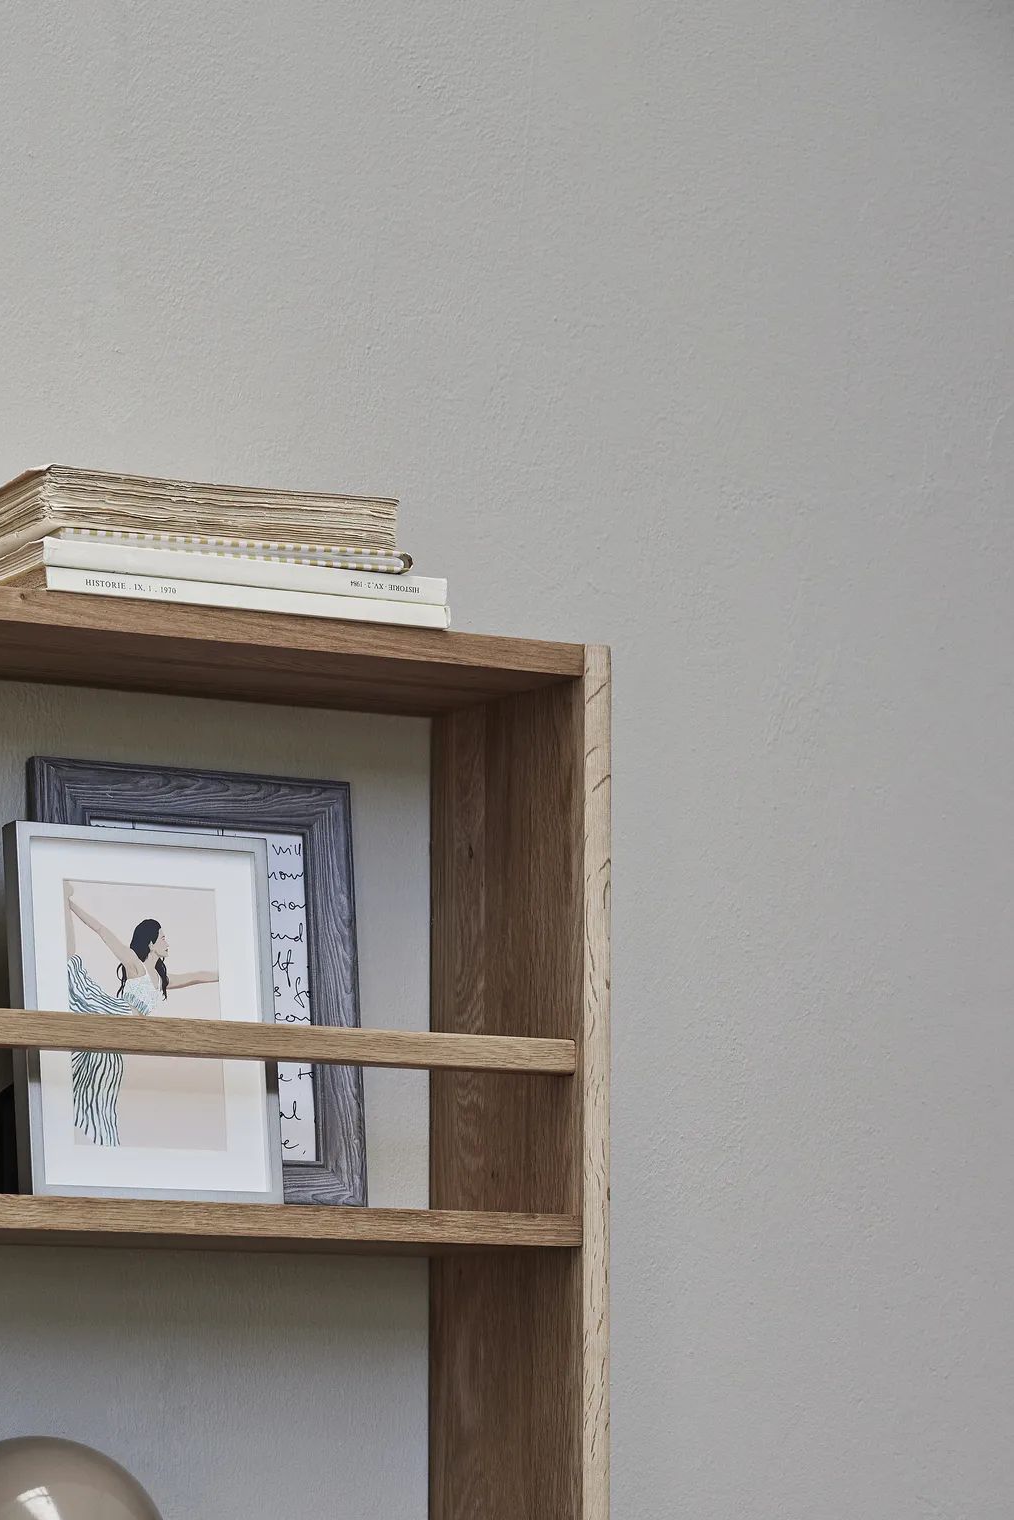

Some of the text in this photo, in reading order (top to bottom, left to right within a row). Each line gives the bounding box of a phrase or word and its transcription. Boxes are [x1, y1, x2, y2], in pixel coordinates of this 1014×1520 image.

[85, 578, 126, 590] HISTORIE
[160, 586, 177, 594] 1970
[350, 580, 363, 588] 1984
[388, 584, 420, 594] HISTORIE
